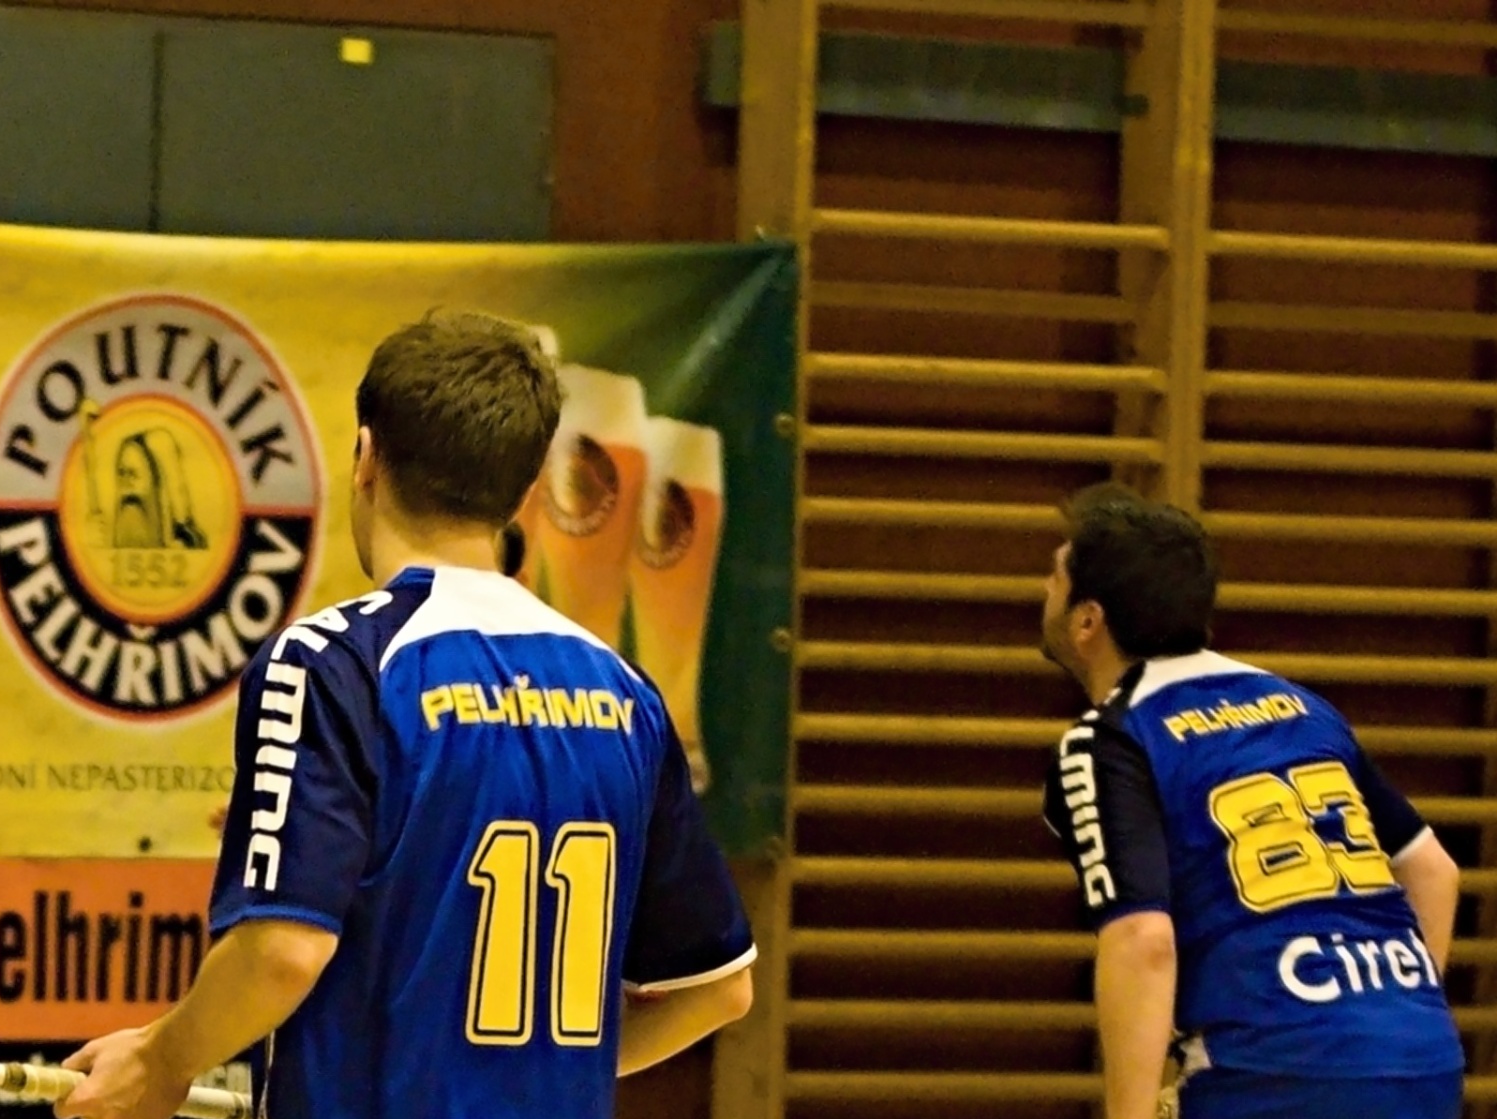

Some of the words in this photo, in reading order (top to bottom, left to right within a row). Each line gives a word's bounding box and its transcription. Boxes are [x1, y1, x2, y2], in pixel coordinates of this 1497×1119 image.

[4, 323, 298, 484] POUTNÍK
[421, 674, 635, 736] PELHŘIMOV
[1163, 693, 1310, 742] PELHŘIMOV
[1208, 760, 1396, 914] 83
[467, 820, 616, 1047] 11
